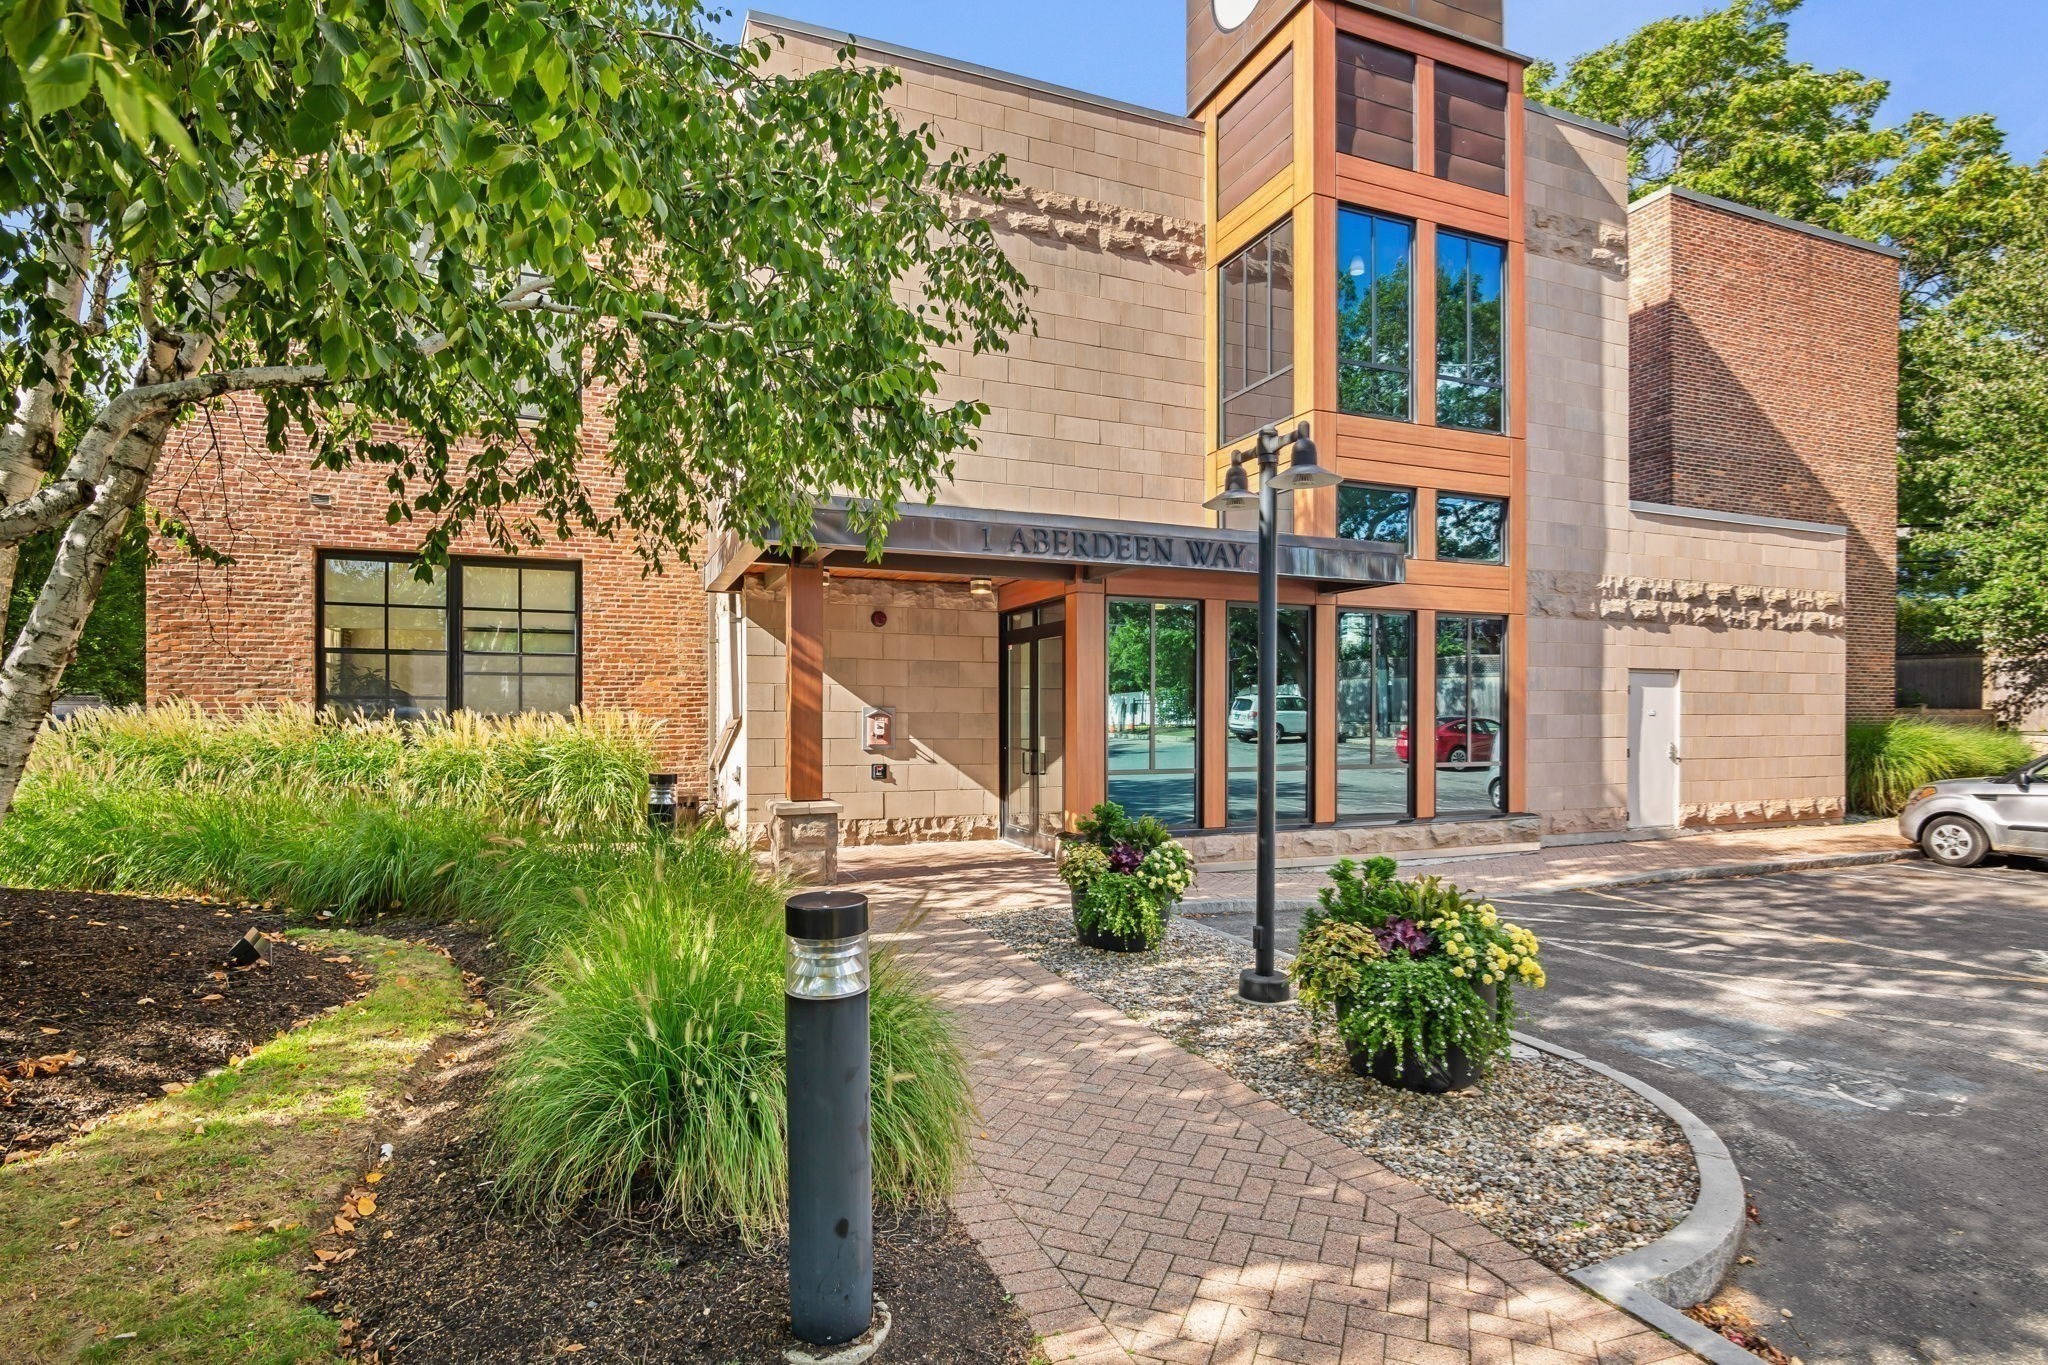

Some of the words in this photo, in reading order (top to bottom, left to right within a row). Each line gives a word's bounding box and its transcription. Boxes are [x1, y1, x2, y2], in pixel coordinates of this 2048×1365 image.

[982, 528, 991, 551] 1
[1009, 528, 1174, 562] ABERDEEN
[1185, 540, 1246, 568] WAY
